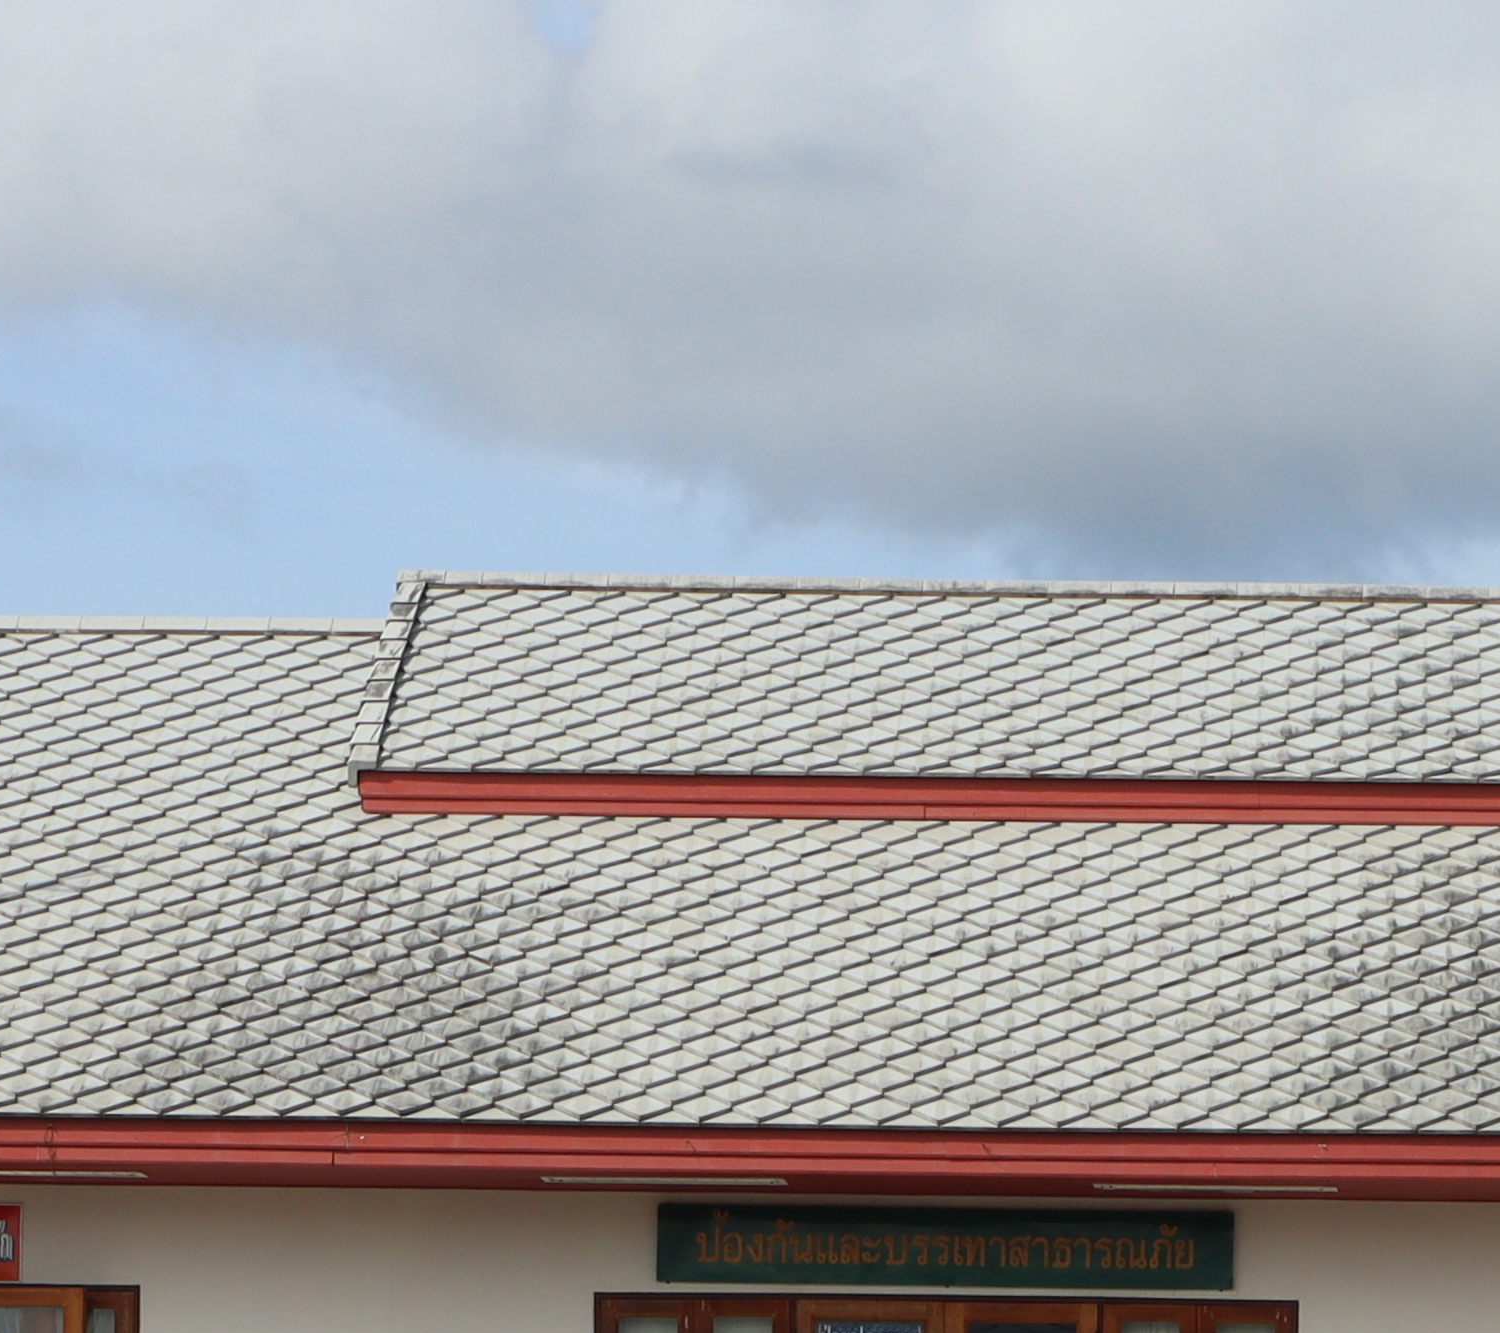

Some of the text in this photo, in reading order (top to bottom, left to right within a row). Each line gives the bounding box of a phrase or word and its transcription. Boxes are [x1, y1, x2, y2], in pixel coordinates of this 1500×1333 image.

[695, 1208, 1197, 1270] ป้องกันและบรรเทาสาธารณภัย
